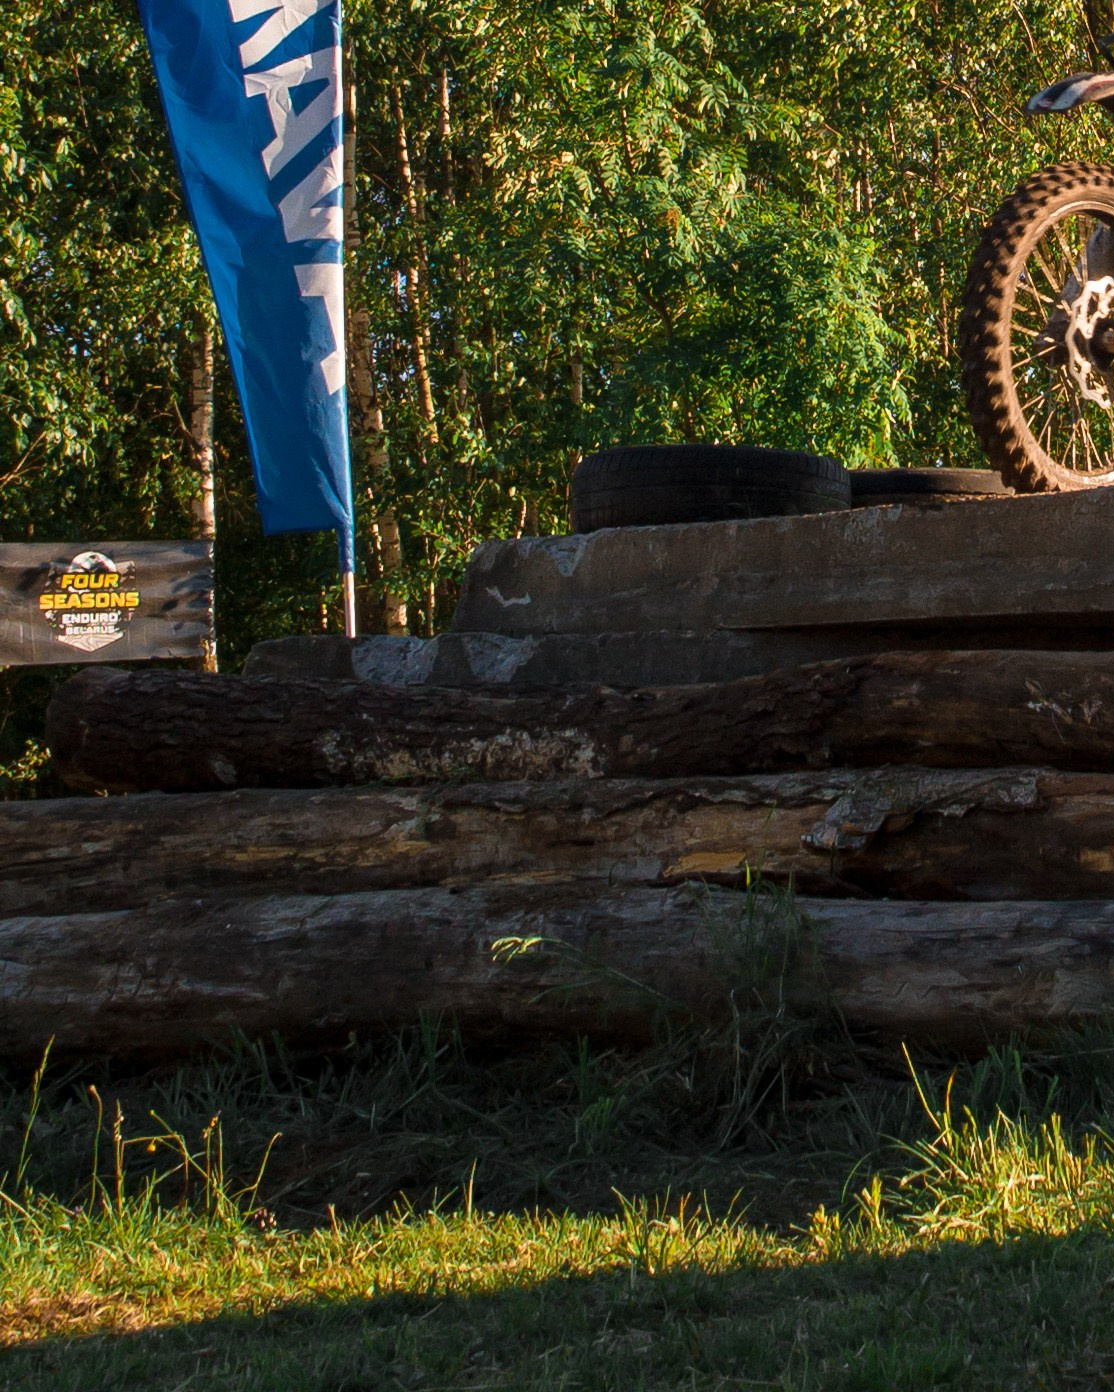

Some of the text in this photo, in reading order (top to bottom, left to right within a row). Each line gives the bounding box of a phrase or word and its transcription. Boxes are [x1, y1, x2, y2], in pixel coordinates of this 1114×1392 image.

[61, 573, 119, 588] FOUR
[39, 592, 140, 609] SEASONS
[62, 612, 119, 624] ENDURO
[65, 626, 115, 635] BELARUS
